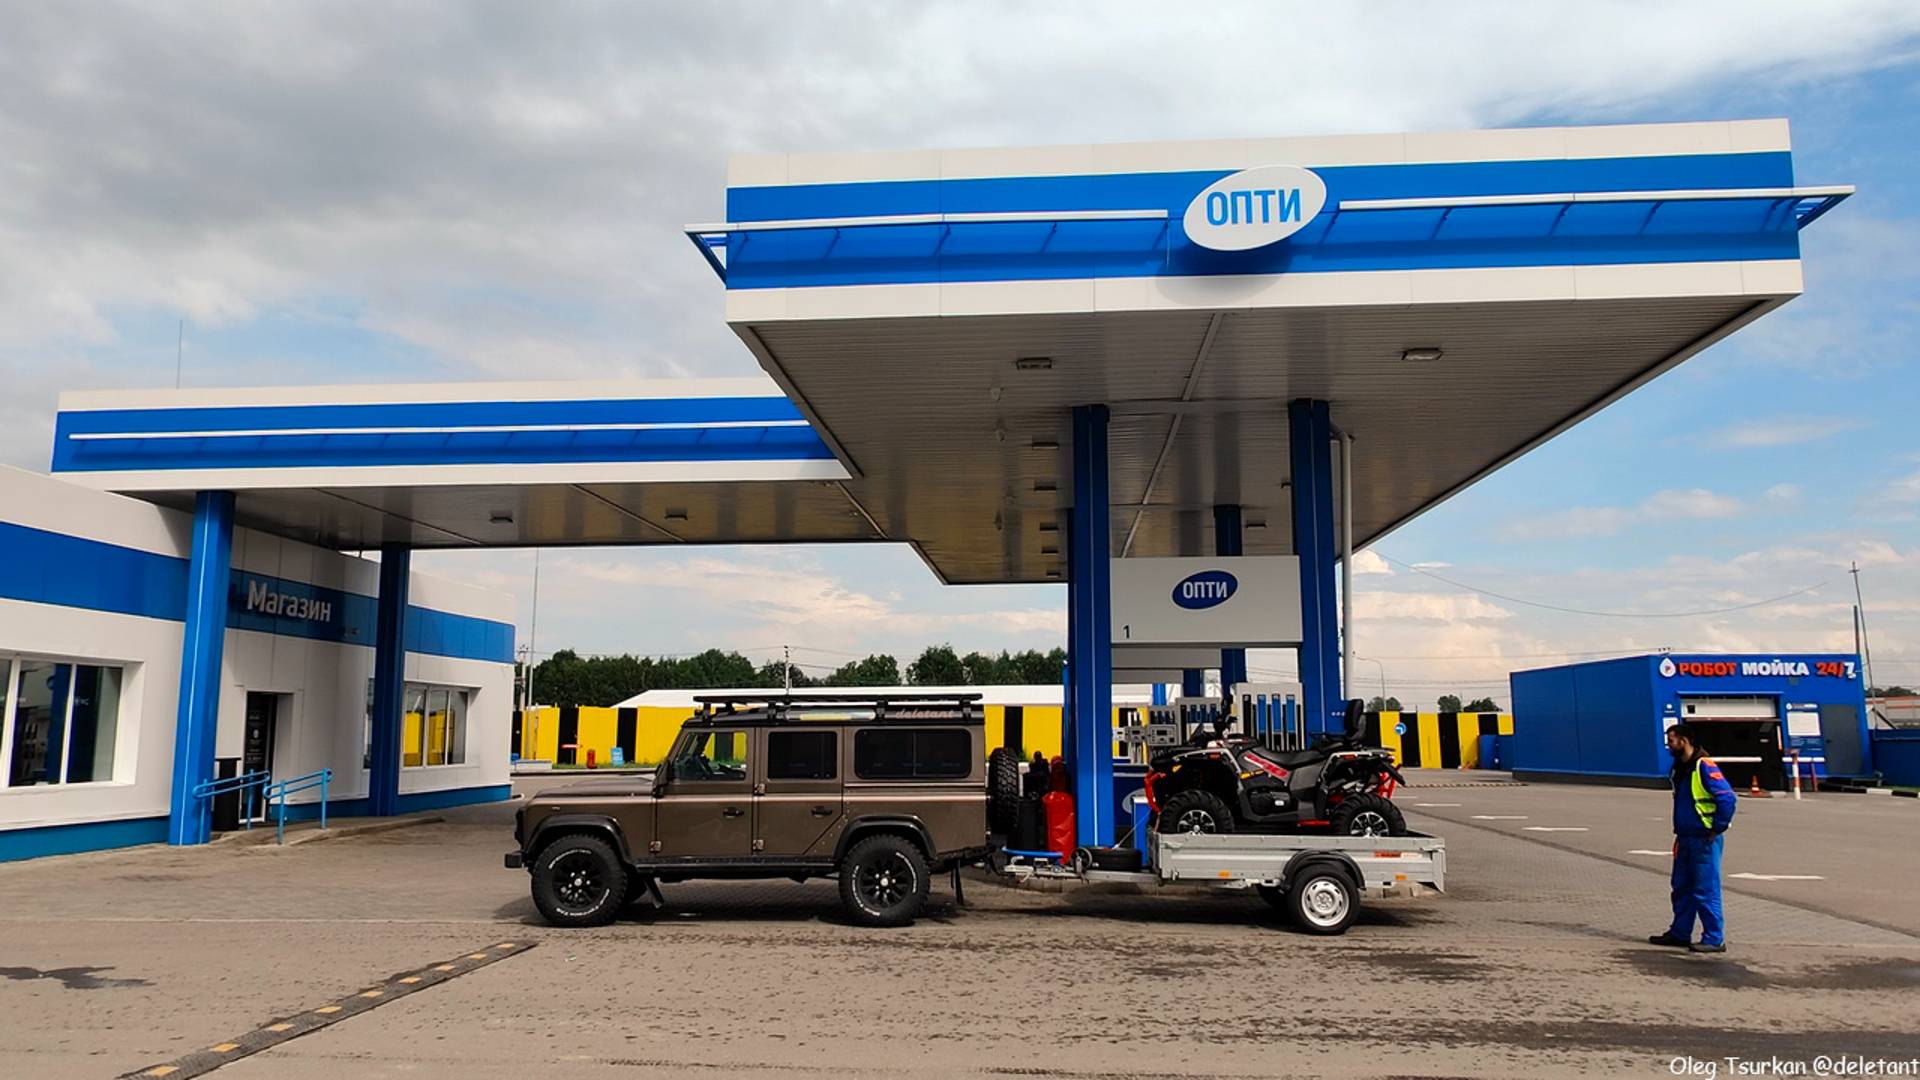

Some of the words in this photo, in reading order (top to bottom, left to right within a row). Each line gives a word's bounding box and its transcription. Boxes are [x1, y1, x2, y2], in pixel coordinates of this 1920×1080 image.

[1205, 188, 1302, 226] ОПТИ
[1182, 581, 1228, 599] ОПТИ
[246, 580, 332, 622] Магазин
[1122, 625, 1131, 639] 1
[1679, 661, 1737, 677] РОБОТ
[1742, 659, 1810, 676] МОЙКА
[1816, 661, 1856, 678] 24/7
